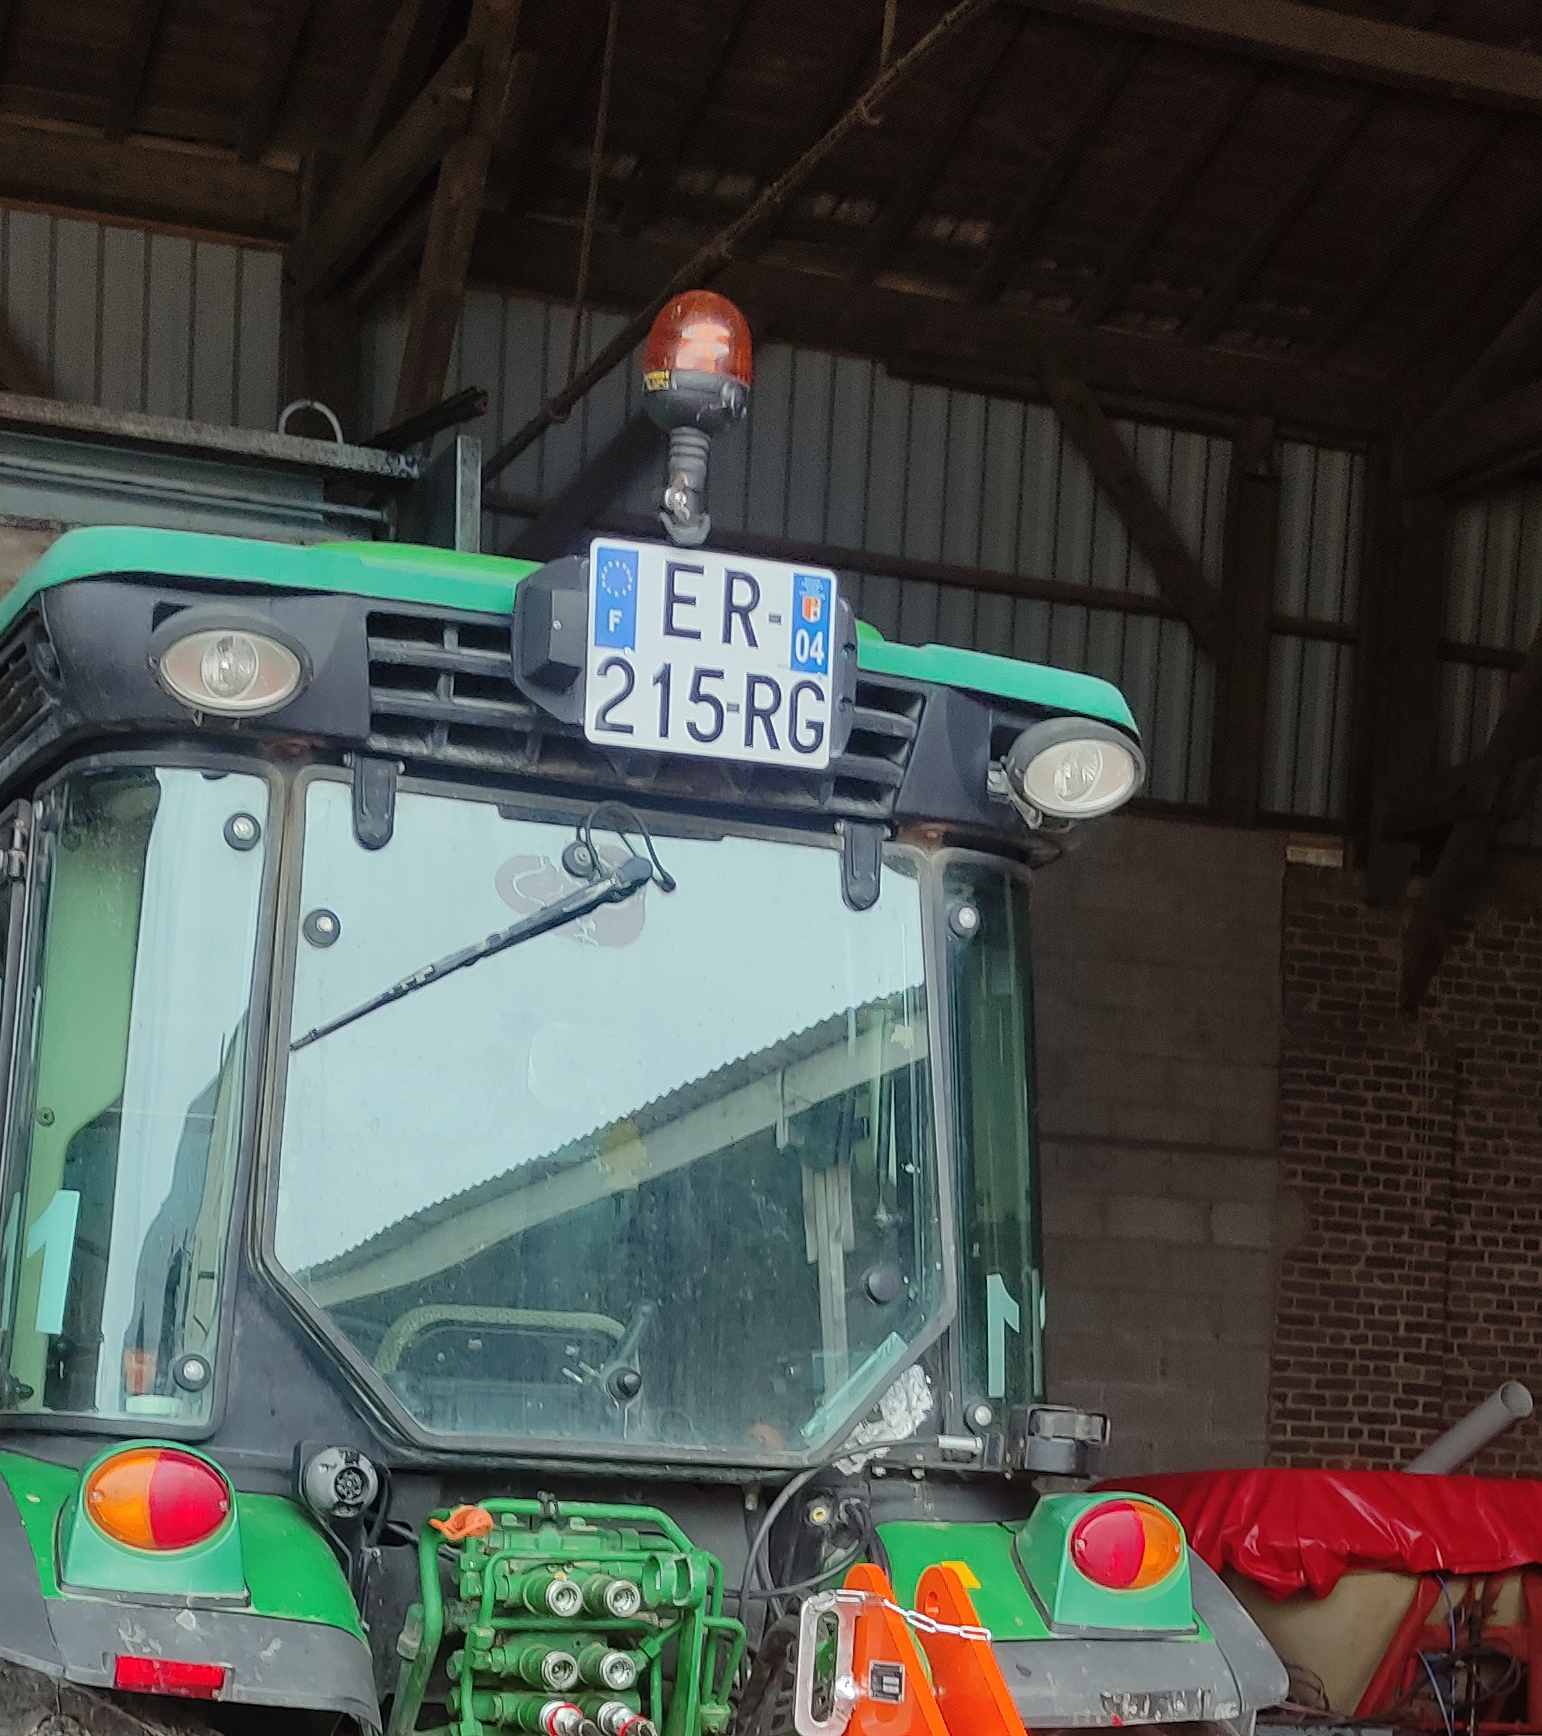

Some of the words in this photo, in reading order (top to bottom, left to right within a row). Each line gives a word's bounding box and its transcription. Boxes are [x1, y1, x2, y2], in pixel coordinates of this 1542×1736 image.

[608, 608, 623, 634] F
[794, 628, 825, 667] 04
[594, 656, 826, 755] 215-RG
